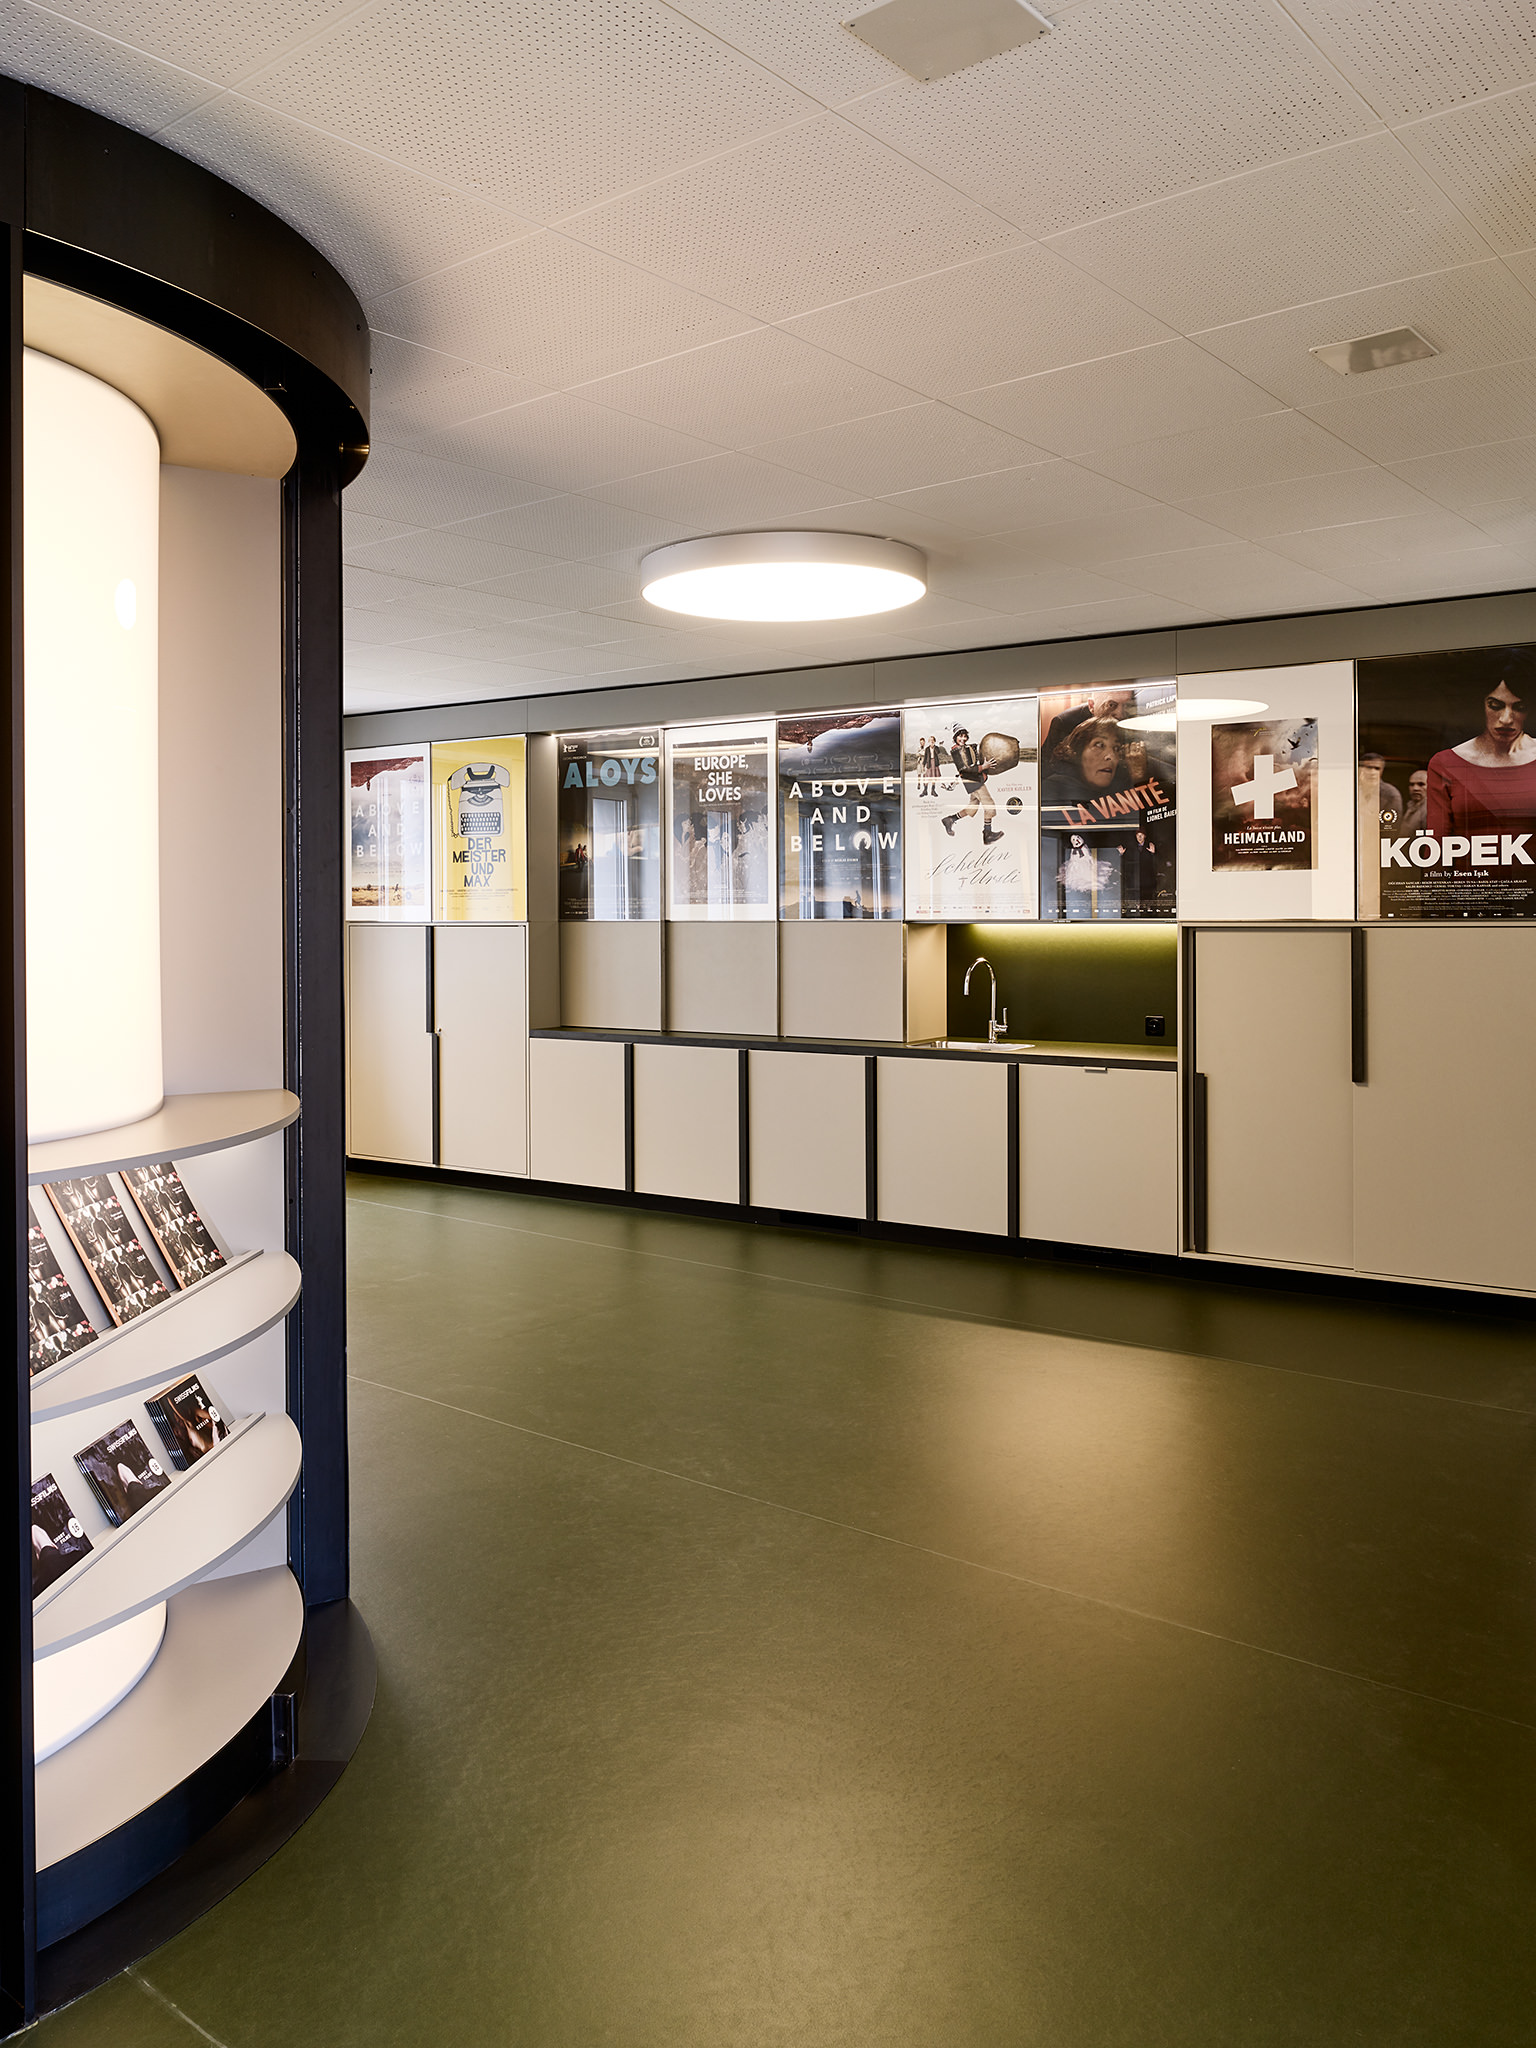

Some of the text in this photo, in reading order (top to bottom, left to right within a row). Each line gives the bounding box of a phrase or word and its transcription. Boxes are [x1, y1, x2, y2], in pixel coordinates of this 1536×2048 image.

[694, 754, 749, 772] EUROPE,
[563, 756, 657, 789] ALOYS
[707, 771, 733, 787] SHE
[698, 787, 742, 803] LOVES
[788, 776, 895, 799] ABOVE
[1061, 776, 1170, 826] LA VANITÉ
[355, 801, 420, 818] ABOVE
[810, 805, 871, 825] AND
[367, 823, 406, 838] AND
[1224, 830, 1306, 845] HEIMATLAND
[468, 837, 492, 851] DER
[790, 830, 898, 852] BELOW
[1380, 829, 1536, 868] KÖPEK
[356, 842, 423, 858] BELOW
[452, 849, 507, 863] MEISTER
[471, 862, 495, 876] UND
[1444, 870, 1453, 879] by
[463, 875, 491, 888] MAX
